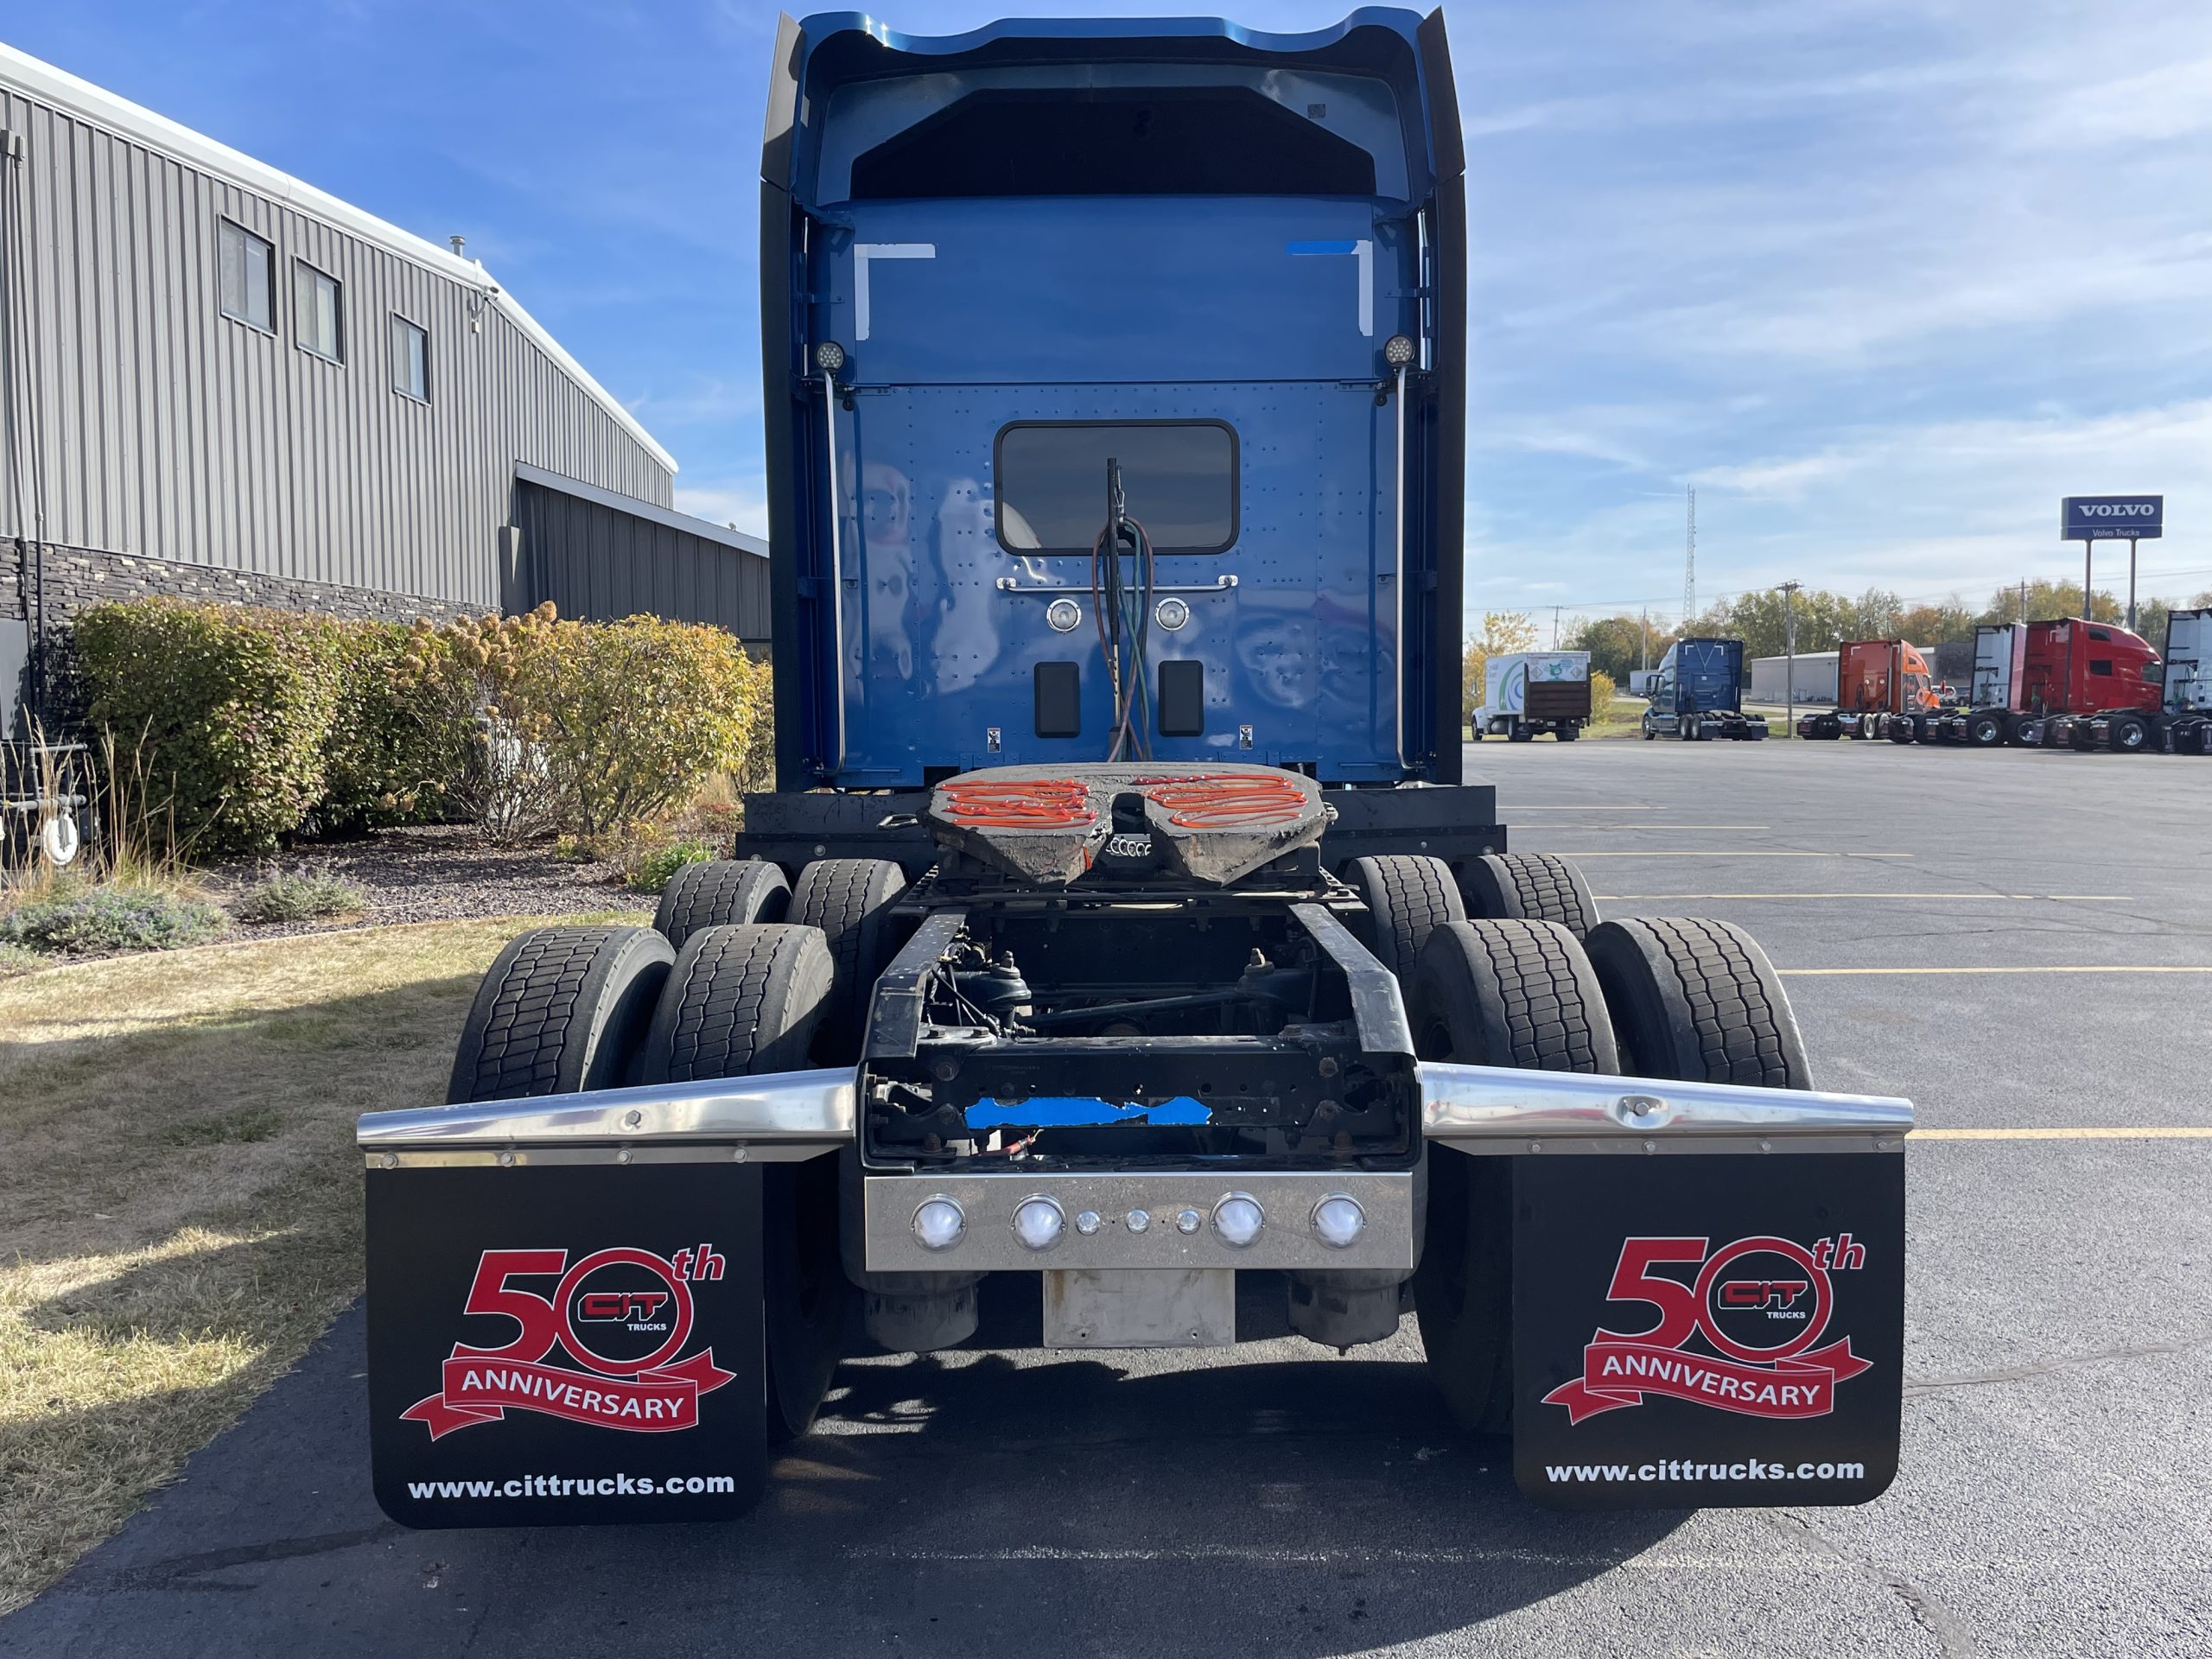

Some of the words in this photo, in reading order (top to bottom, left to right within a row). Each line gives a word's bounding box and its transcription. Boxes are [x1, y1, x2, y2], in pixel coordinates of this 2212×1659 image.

[2079, 504, 2154, 516] VOLVO
[2116, 528, 2139, 537] Trucks
[578, 1293, 668, 1321] CIT
[1718, 1281, 1808, 1309] CIT
[626, 1323, 666, 1332] TRUCKS
[1602, 1355, 1820, 1406] ANNIVERSARY
[461, 1370, 683, 1419] ANNIVERSARY
[1546, 1459, 1864, 1482] www.cittrucks.com
[408, 1473, 734, 1498] www.cittrucks.com
